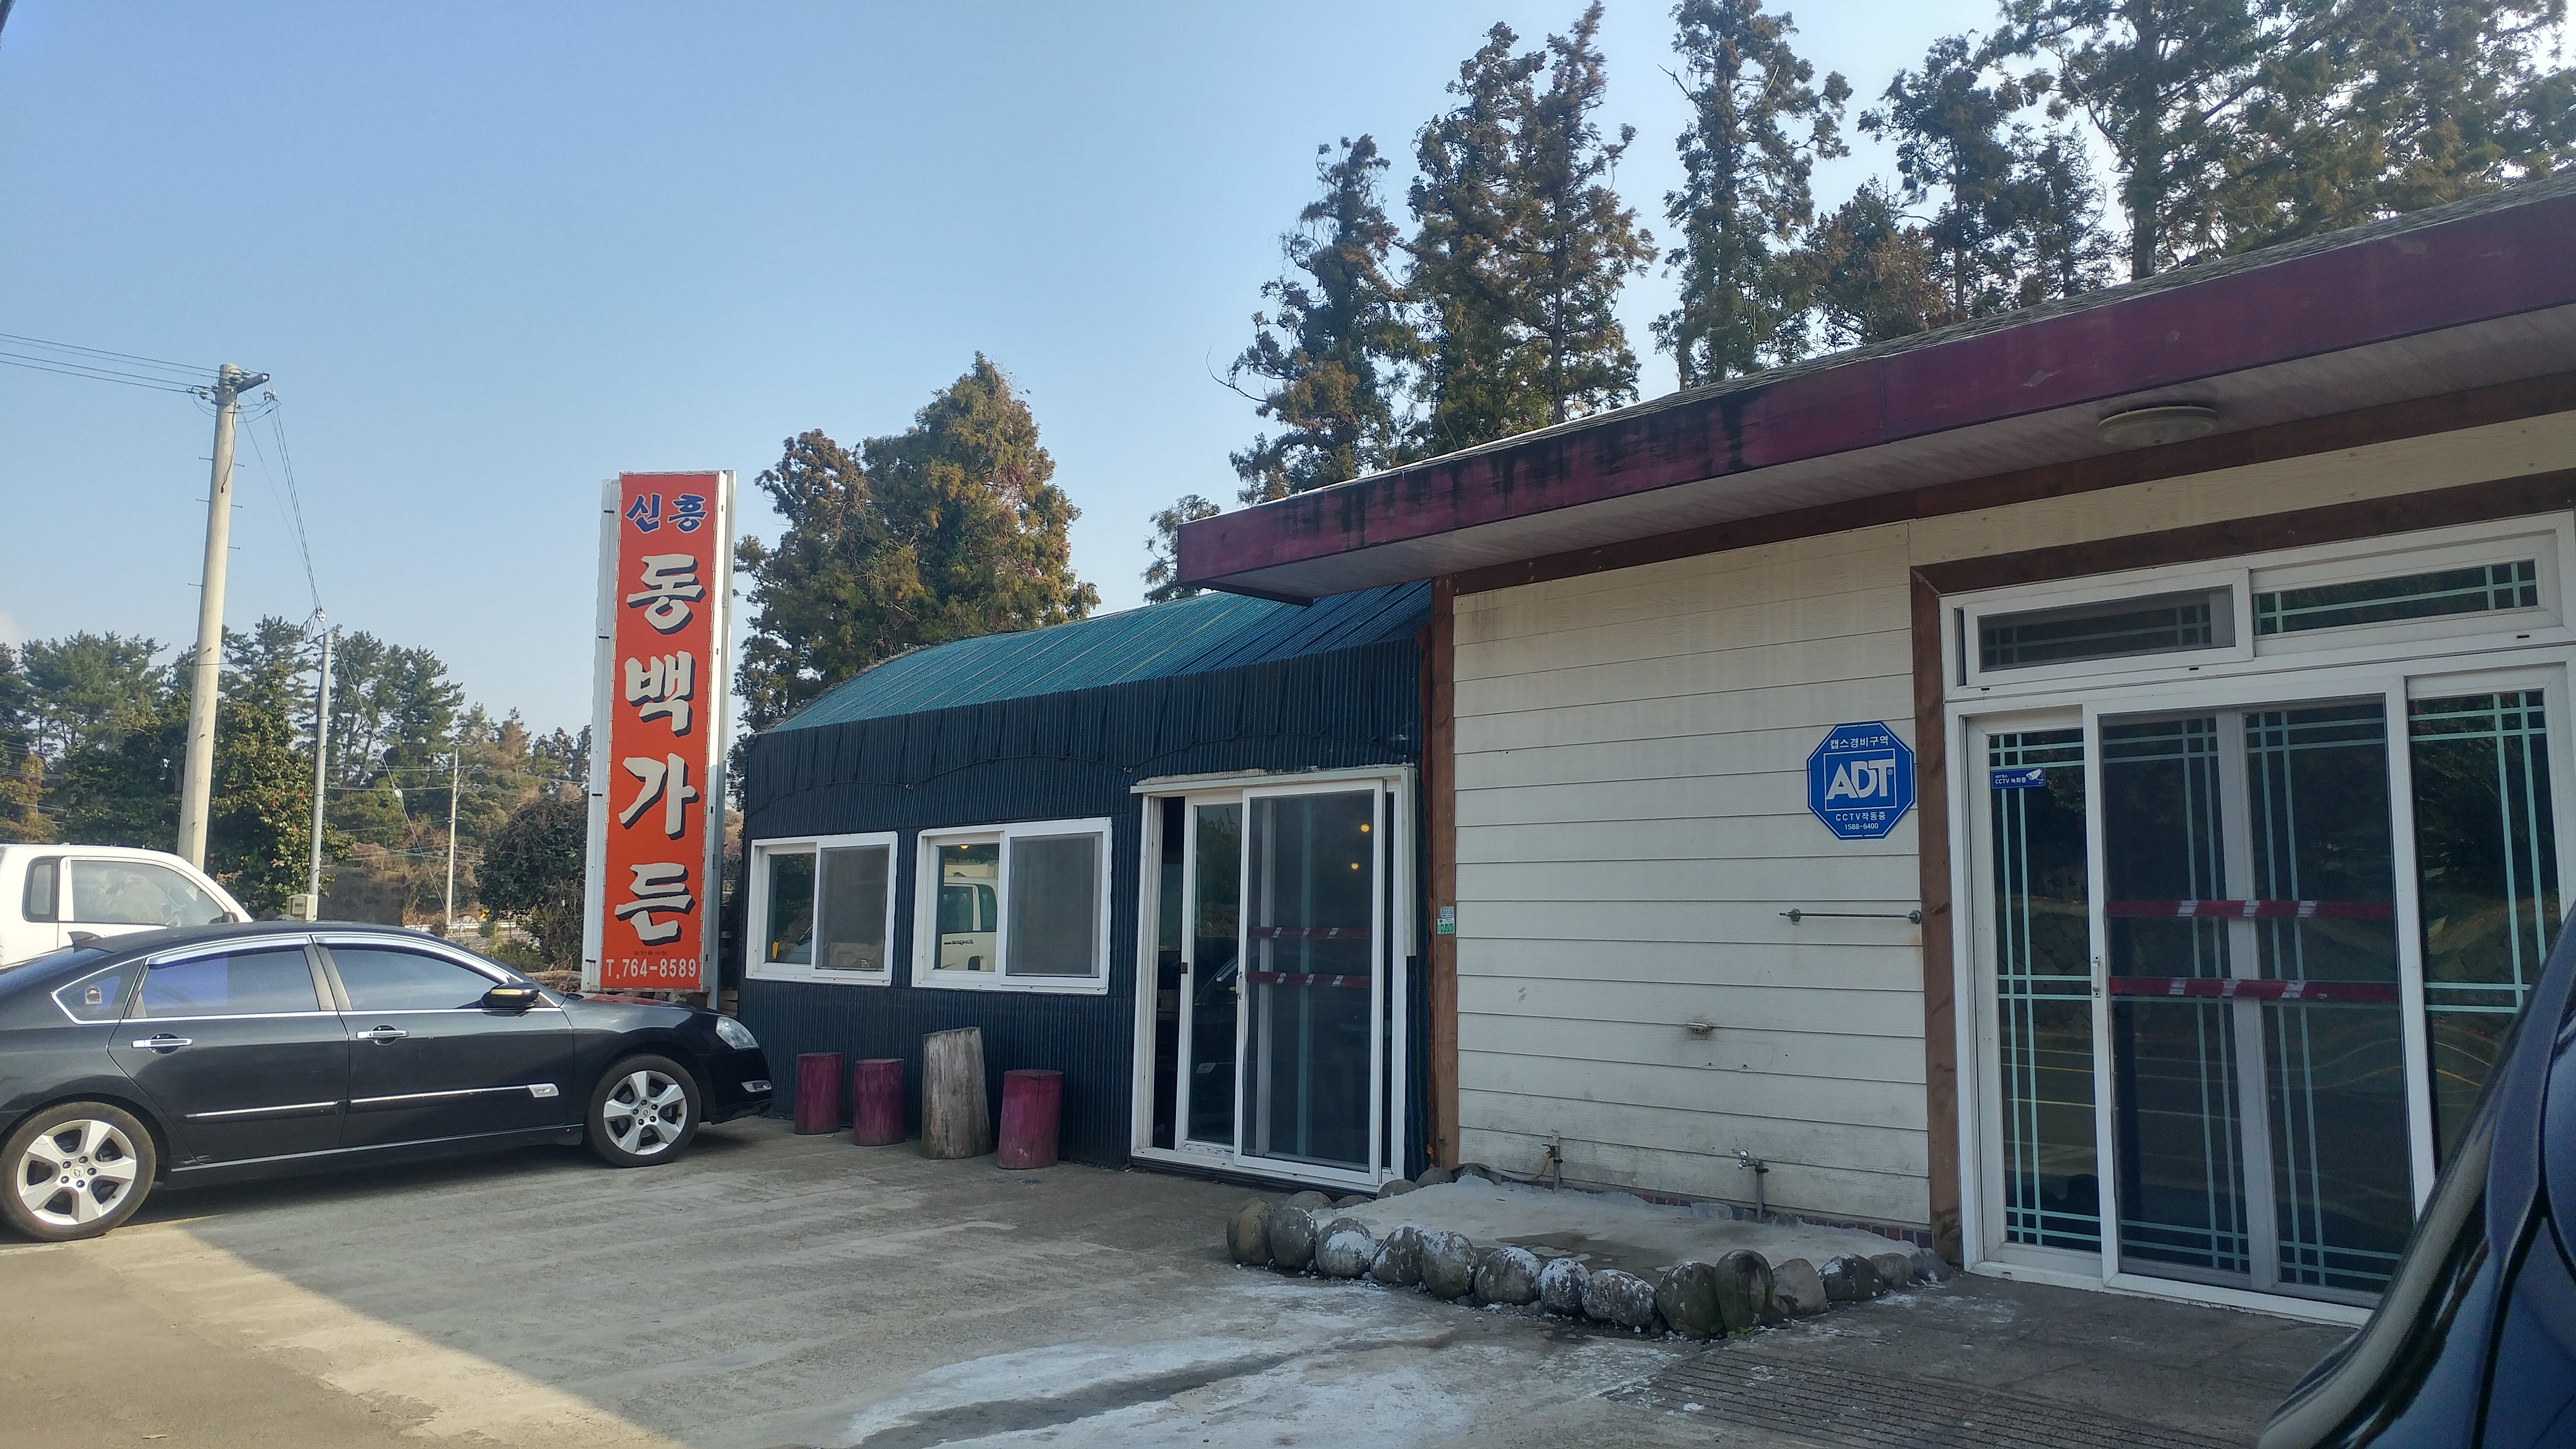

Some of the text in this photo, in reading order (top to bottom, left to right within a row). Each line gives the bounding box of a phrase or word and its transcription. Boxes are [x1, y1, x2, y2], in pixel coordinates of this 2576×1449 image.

[625, 493, 708, 533] 신흥
[614, 554, 706, 946] 동백가든
[1830, 735, 1888, 750] 캡스경비구역
[1826, 758, 1895, 800] ADT
[606, 958, 696, 979] T.764-8589
